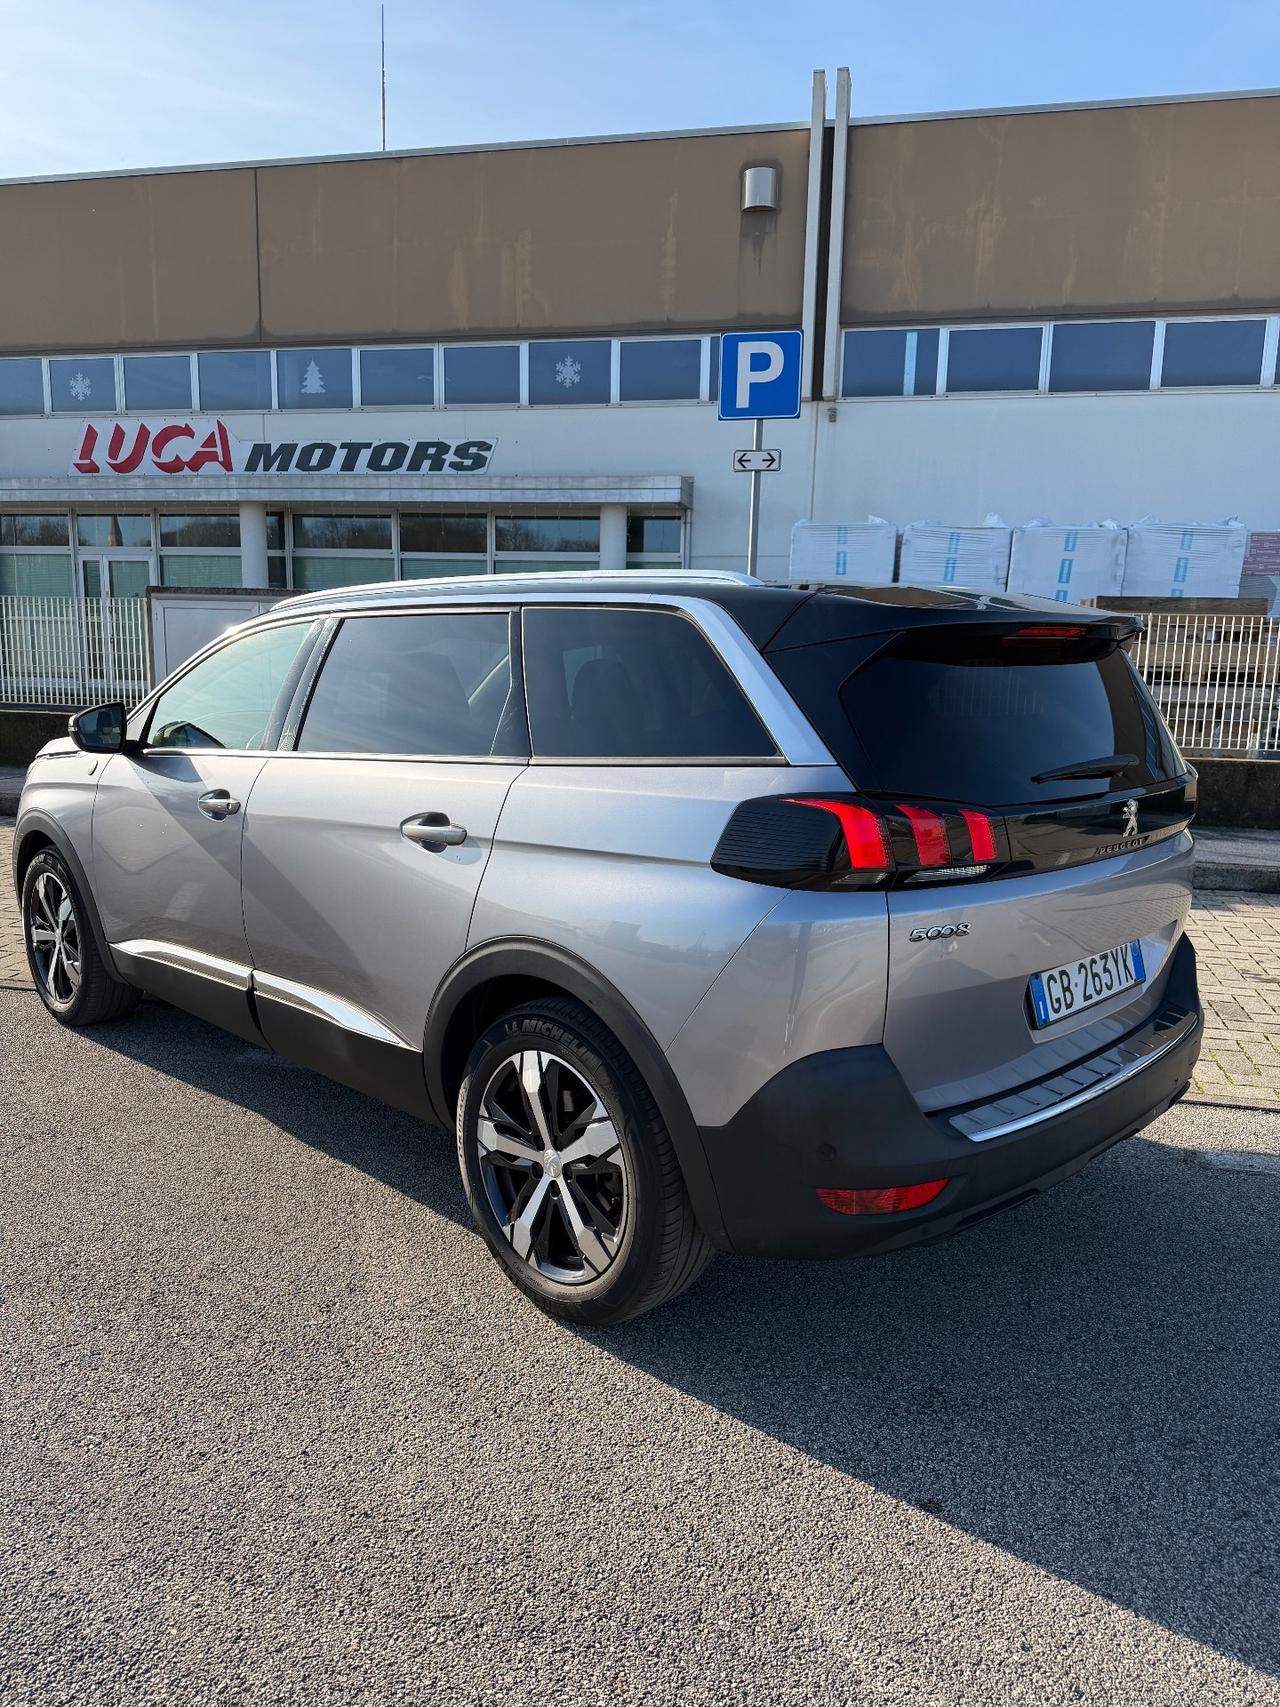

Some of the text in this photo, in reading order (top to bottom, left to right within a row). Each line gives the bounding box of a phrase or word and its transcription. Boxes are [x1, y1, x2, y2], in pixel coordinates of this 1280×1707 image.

[736, 341, 784, 408] P
[73, 419, 493, 474] LUCA MOTORS
[1098, 837, 1145, 856] PEUGEOT
[909, 922, 971, 942] 5008
[522, 1019, 602, 1073] MICHELIN
